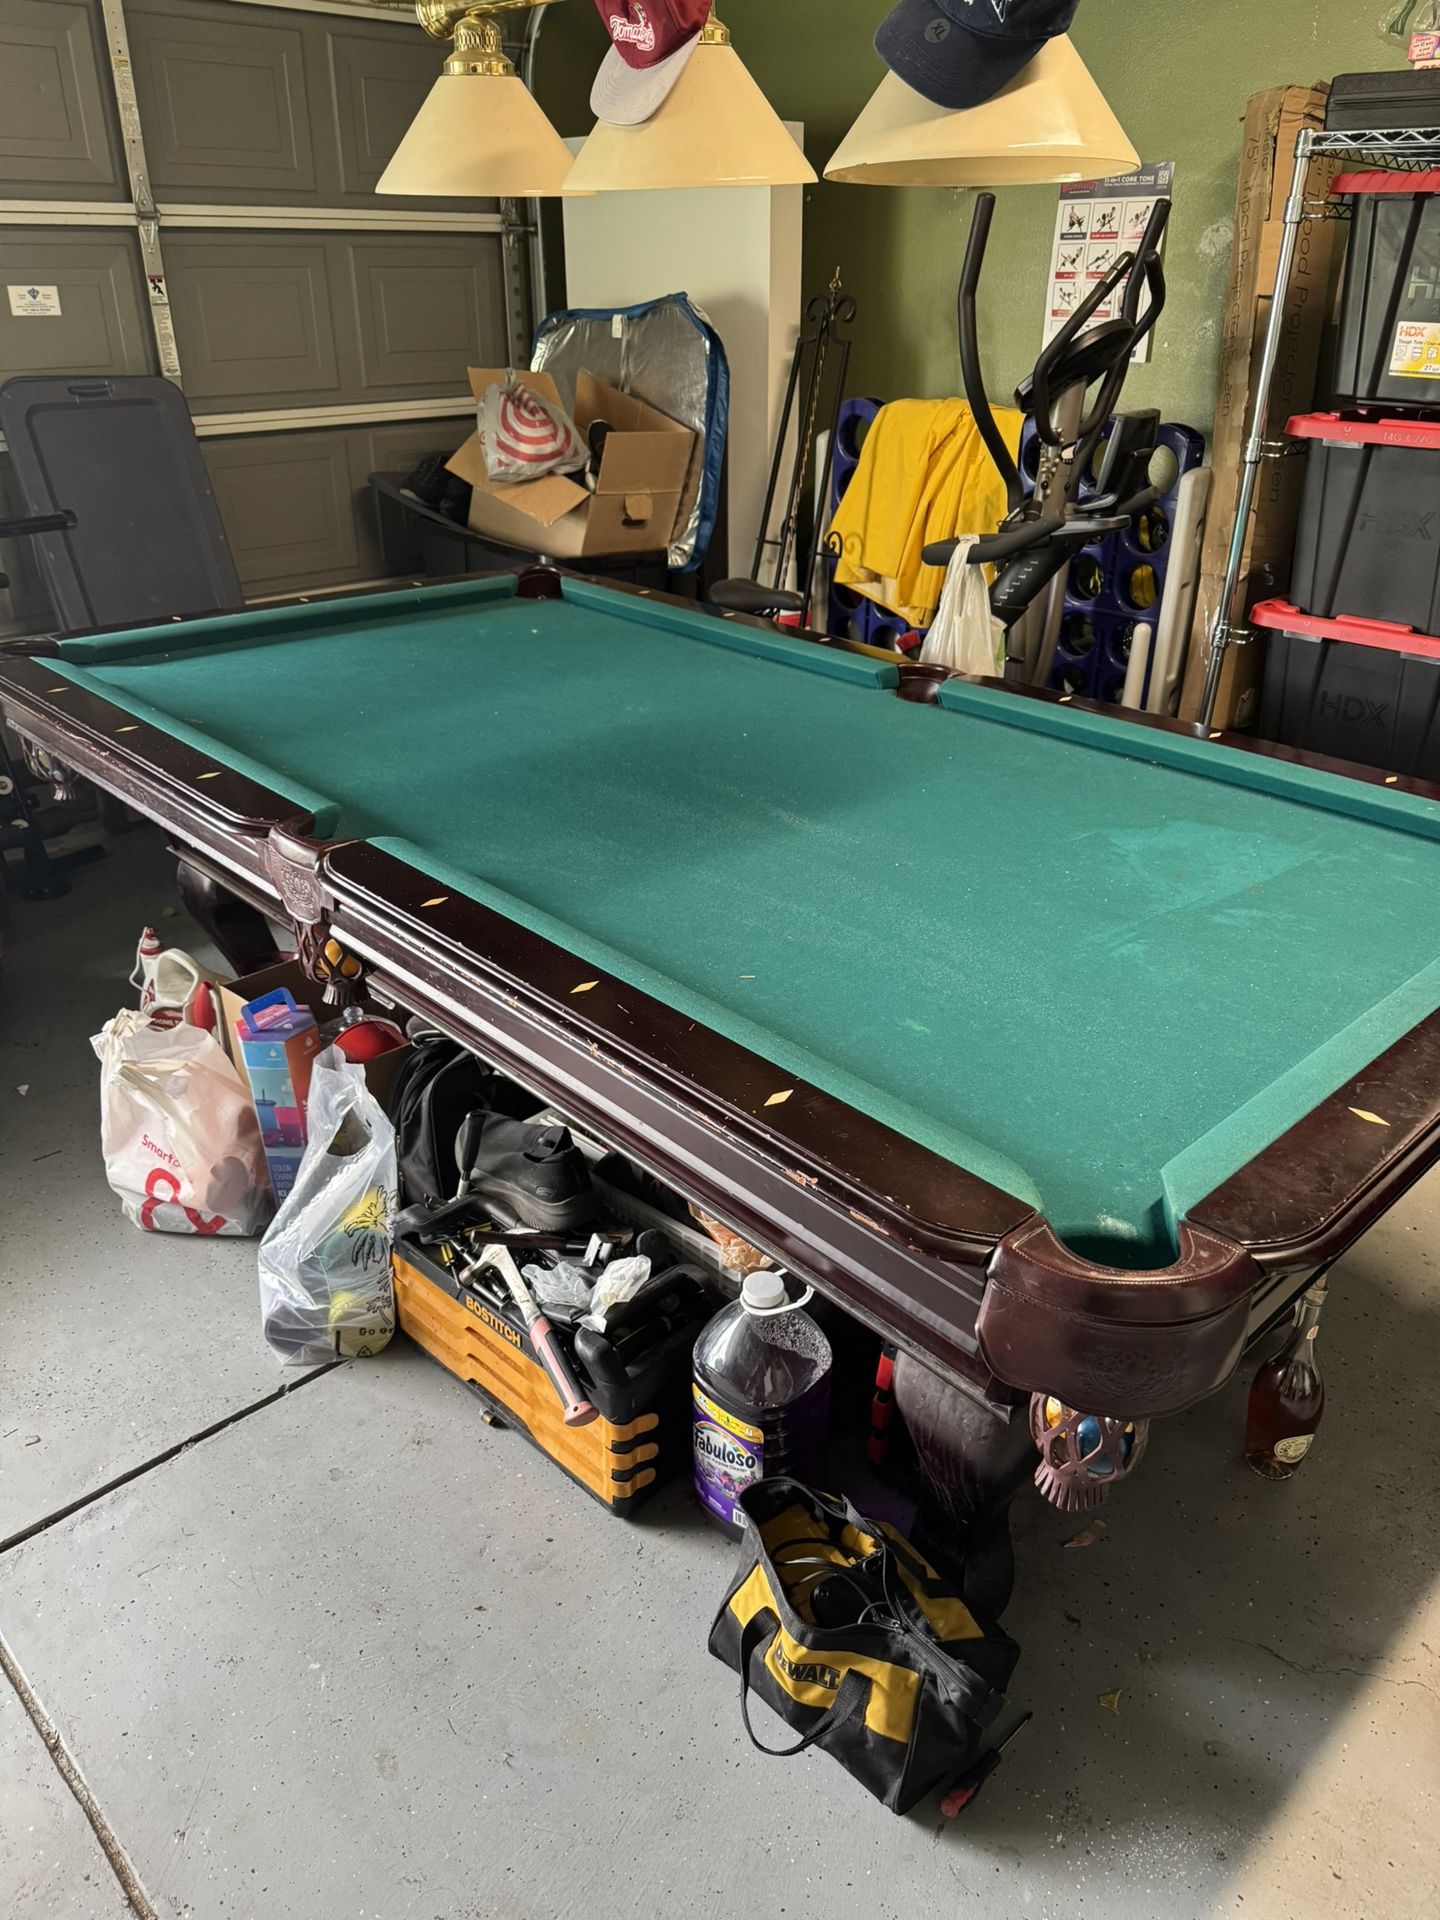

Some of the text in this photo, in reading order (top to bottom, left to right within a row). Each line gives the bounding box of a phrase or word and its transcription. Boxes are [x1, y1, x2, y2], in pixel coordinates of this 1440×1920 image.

[1282, 286, 1310, 408] Projector
[1400, 326, 1424, 337] HDX
[1318, 690, 1390, 728] HDX
[465, 1295, 521, 1347] BOSTITCH
[695, 1429, 757, 1469] Fabuloso
